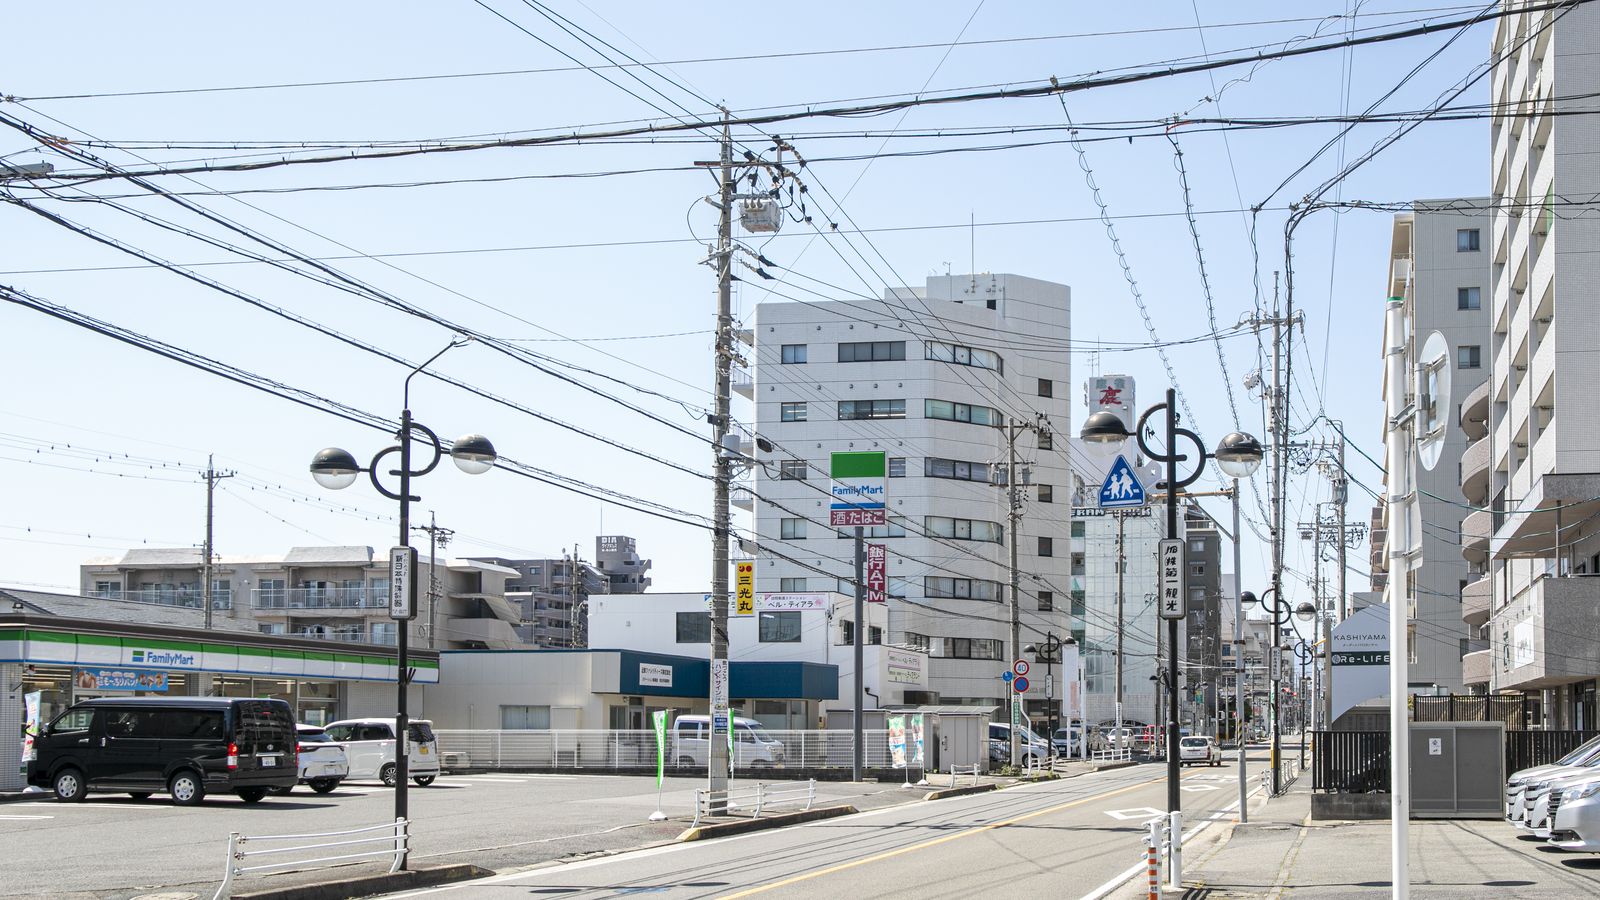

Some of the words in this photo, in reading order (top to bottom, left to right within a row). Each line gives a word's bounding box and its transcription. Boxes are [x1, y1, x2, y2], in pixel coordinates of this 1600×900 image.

[832, 485, 883, 496] FamilyMart
[739, 576, 753, 611] 三光丸
[147, 652, 194, 666] FamilyMart
[1340, 655, 1390, 663] Re-LIFE
[1017, 664, 1026, 672] 40
